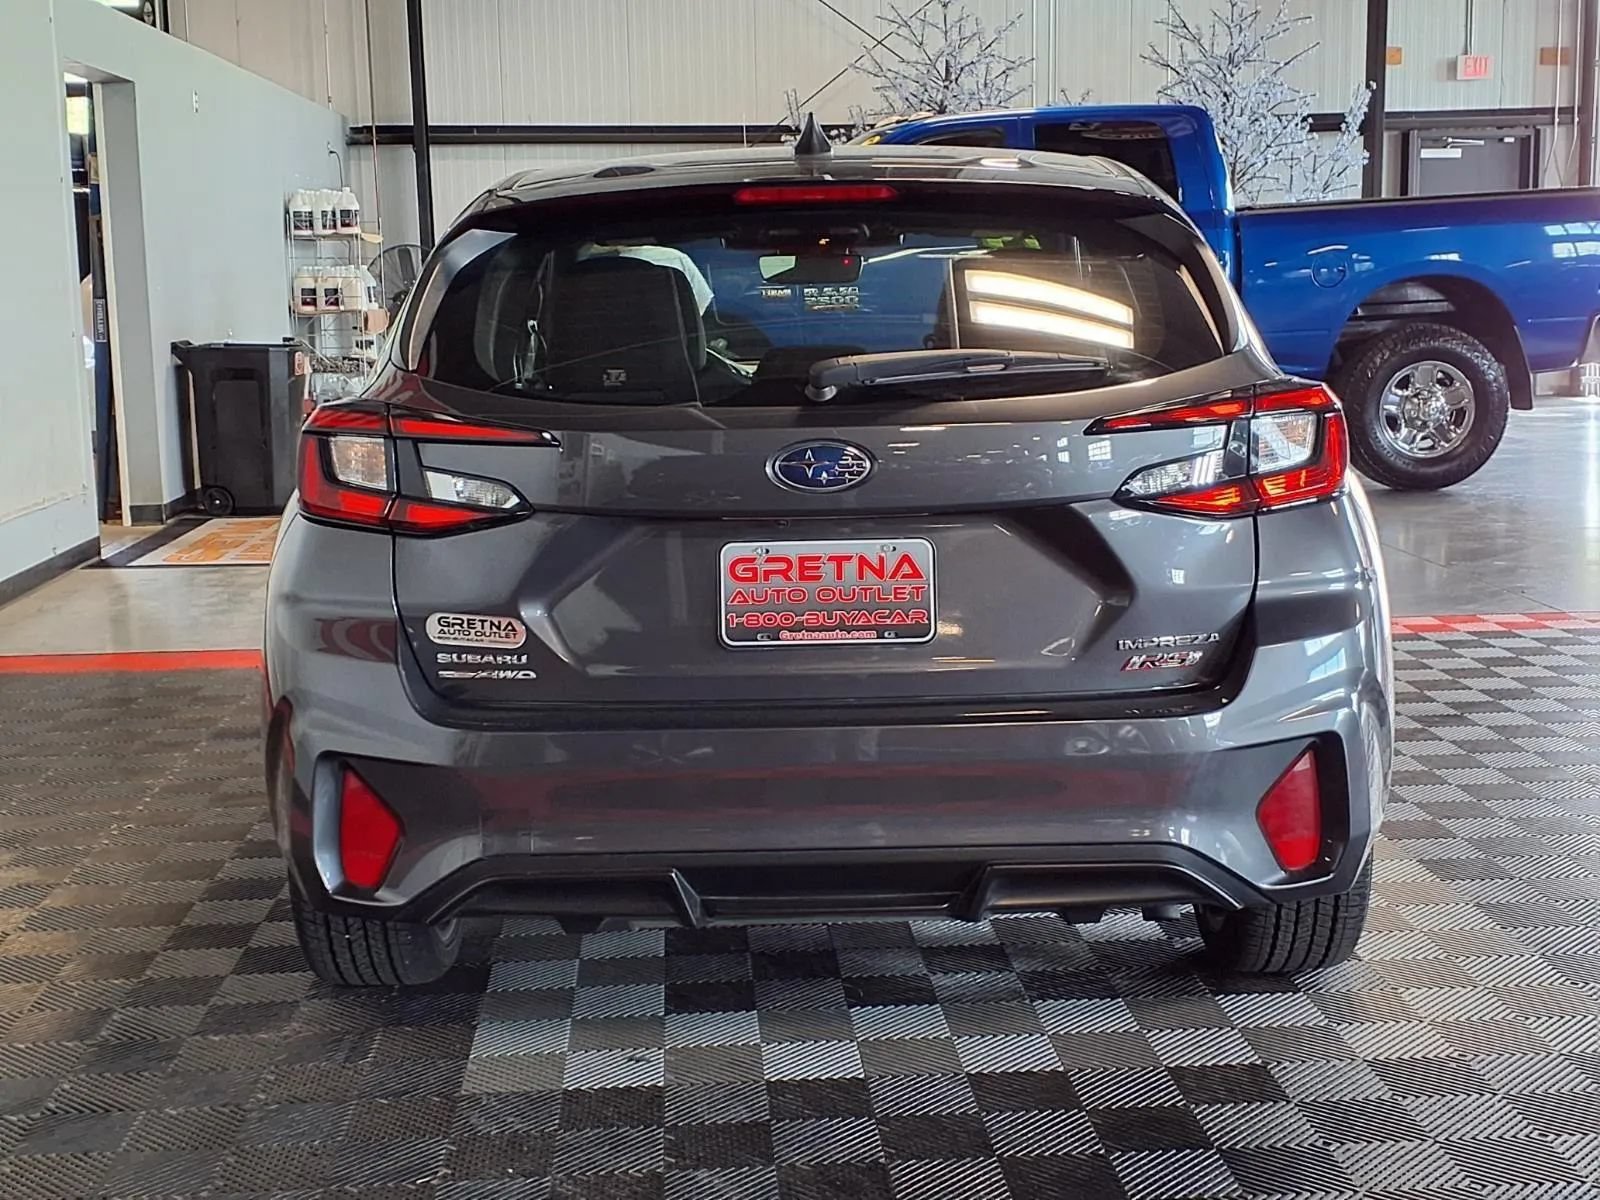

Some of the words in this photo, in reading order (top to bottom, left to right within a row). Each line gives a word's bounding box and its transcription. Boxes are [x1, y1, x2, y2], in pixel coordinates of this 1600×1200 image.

[1464, 56, 1489, 77] EXIT
[728, 552, 927, 583] GRETNA
[727, 587, 808, 605] AUTO
[816, 584, 928, 604] OUTLET
[437, 616, 518, 633] GRETNA
[727, 609, 928, 628] 1-800-BUYACAR
[474, 630, 518, 639] OUTLET
[779, 630, 877, 641] Gretnaauto.com
[1117, 632, 1220, 650] IMPREZA
[436, 652, 528, 665] SUBARU
